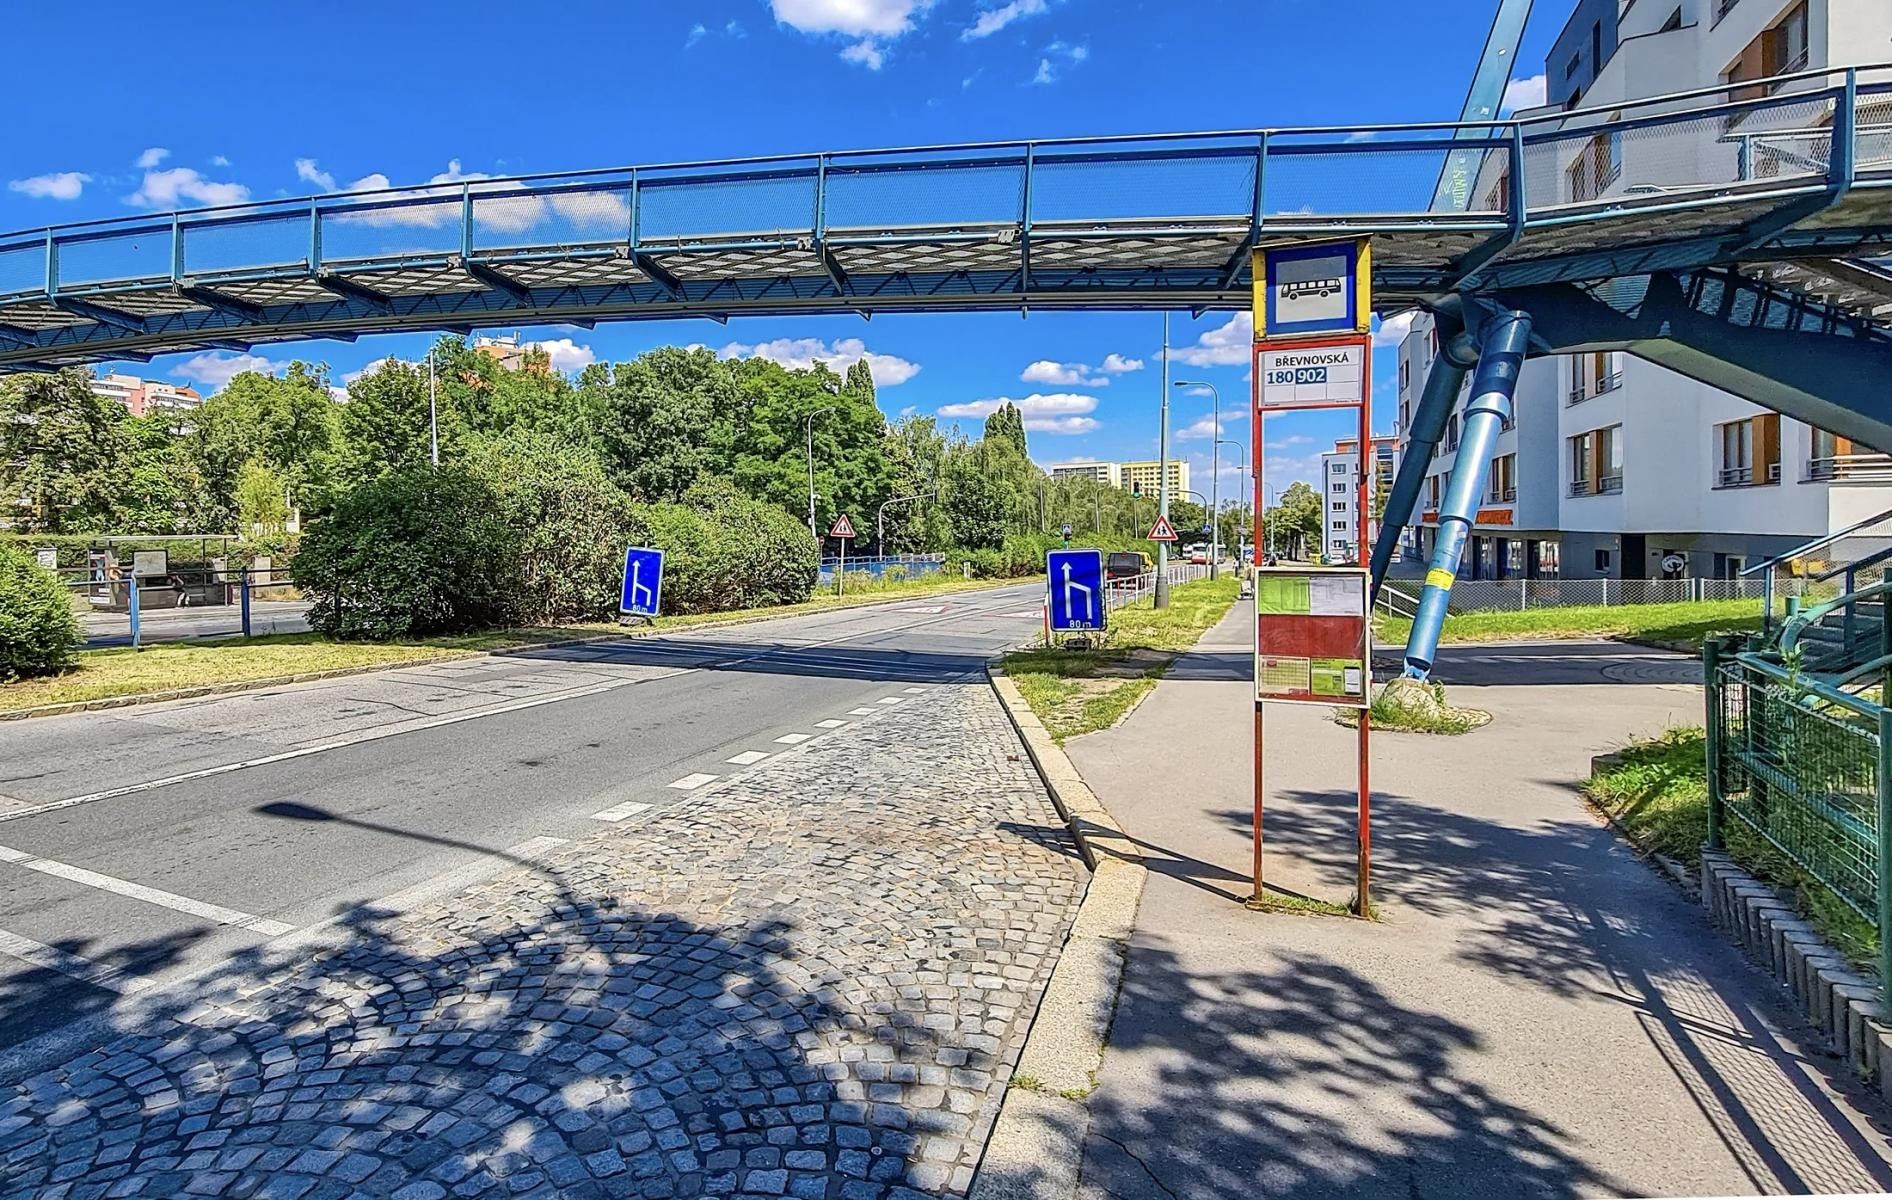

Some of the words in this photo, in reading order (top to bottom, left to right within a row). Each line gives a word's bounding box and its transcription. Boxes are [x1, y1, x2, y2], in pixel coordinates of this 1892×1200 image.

[1275, 352, 1349, 367] BŘEVNOVSKÁ
[1266, 370, 1294, 384] 180
[1297, 369, 1325, 383] 902
[1069, 619, 1081, 628] 80
